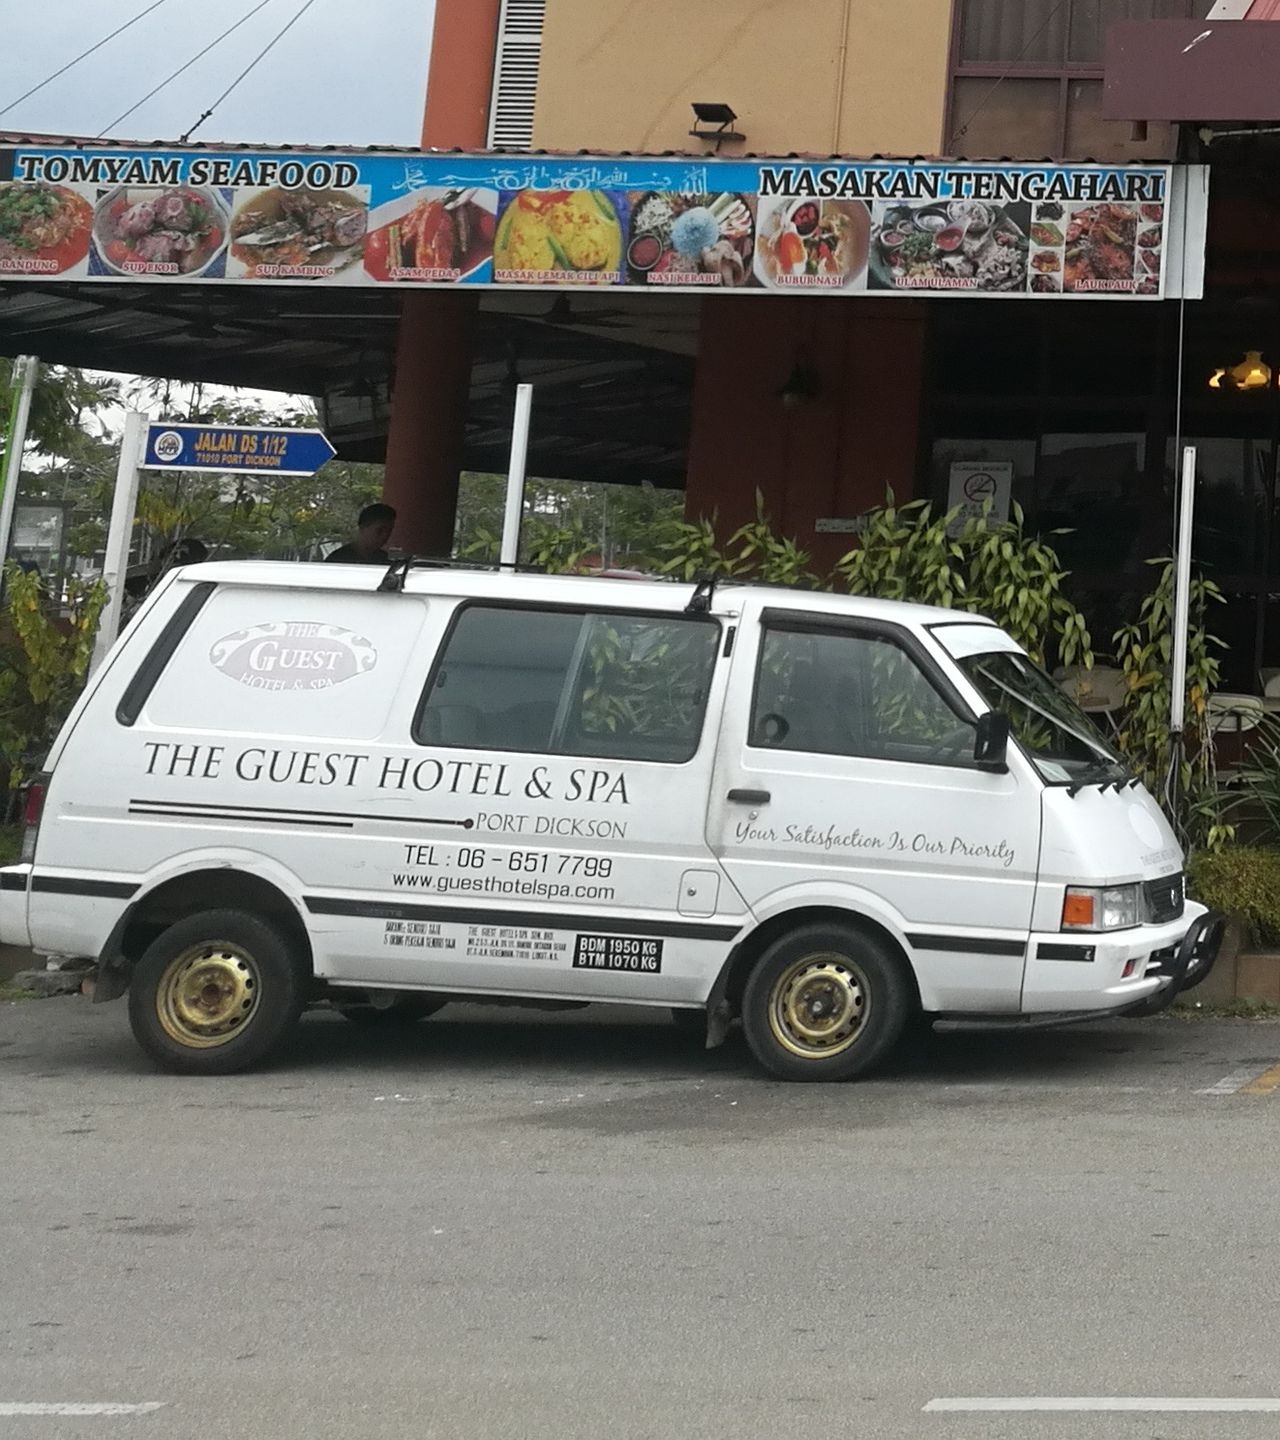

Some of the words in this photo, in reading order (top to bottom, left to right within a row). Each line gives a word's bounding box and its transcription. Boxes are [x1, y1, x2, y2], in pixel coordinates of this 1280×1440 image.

[20, 156, 181, 186] TOMYAM
[190, 160, 358, 189] SEAFOOD
[759, 168, 941, 199] MASAKAN
[947, 171, 1165, 202] TENGAHARI
[123, 262, 144, 272] SUP
[256, 265, 279, 275] SUP
[281, 266, 335, 277] KAMBING
[389, 268, 422, 278] ASAM
[424, 268, 461, 279] PEDAS
[495, 270, 535, 281] MASAK
[536, 271, 574, 282] LEMAK
[602, 271, 621, 282] API
[647, 273, 674, 284] NASI
[675, 274, 721, 285] KERABU
[777, 274, 815, 286] BUBUR
[816, 275, 843, 287] NASI
[895, 277, 930, 288] ULAM
[1074, 279, 1105, 290] LAUK
[193, 432, 237, 453] JALAN
[239, 433, 258, 454] DS
[262, 435, 288, 456] 1/12
[221, 453, 243, 466] PORT
[245, 455, 281, 467] DICKSON
[287, 623, 320, 638] THE
[249, 640, 344, 672] GUEST
[142, 741, 227, 779] THE
[235, 745, 369, 788] GUEST
[376, 756, 512, 797] HOTEL
[523, 765, 553, 800] &
[563, 767, 632, 805] SPA
[474, 812, 530, 835] PORT
[534, 815, 629, 840] DICKSON
[735, 820, 780, 846] Your
[784, 823, 885, 850] Satisfaction
[888, 830, 907, 852] Is
[911, 832, 946, 854] Our
[949, 835, 1017, 867] Priority
[403, 844, 440, 867] TEL
[456, 847, 485, 870] 06
[508, 850, 549, 874] 651
[558, 854, 613, 878] 7799
[392, 872, 616, 900] www.guesthotelspa.com
[579, 937, 606, 952] BDM
[609, 938, 640, 954] 1950
[641, 940, 658, 955] KG
[578, 951, 605, 967] BTM
[608, 953, 639, 969] 1070
[640, 955, 657, 970] KG
